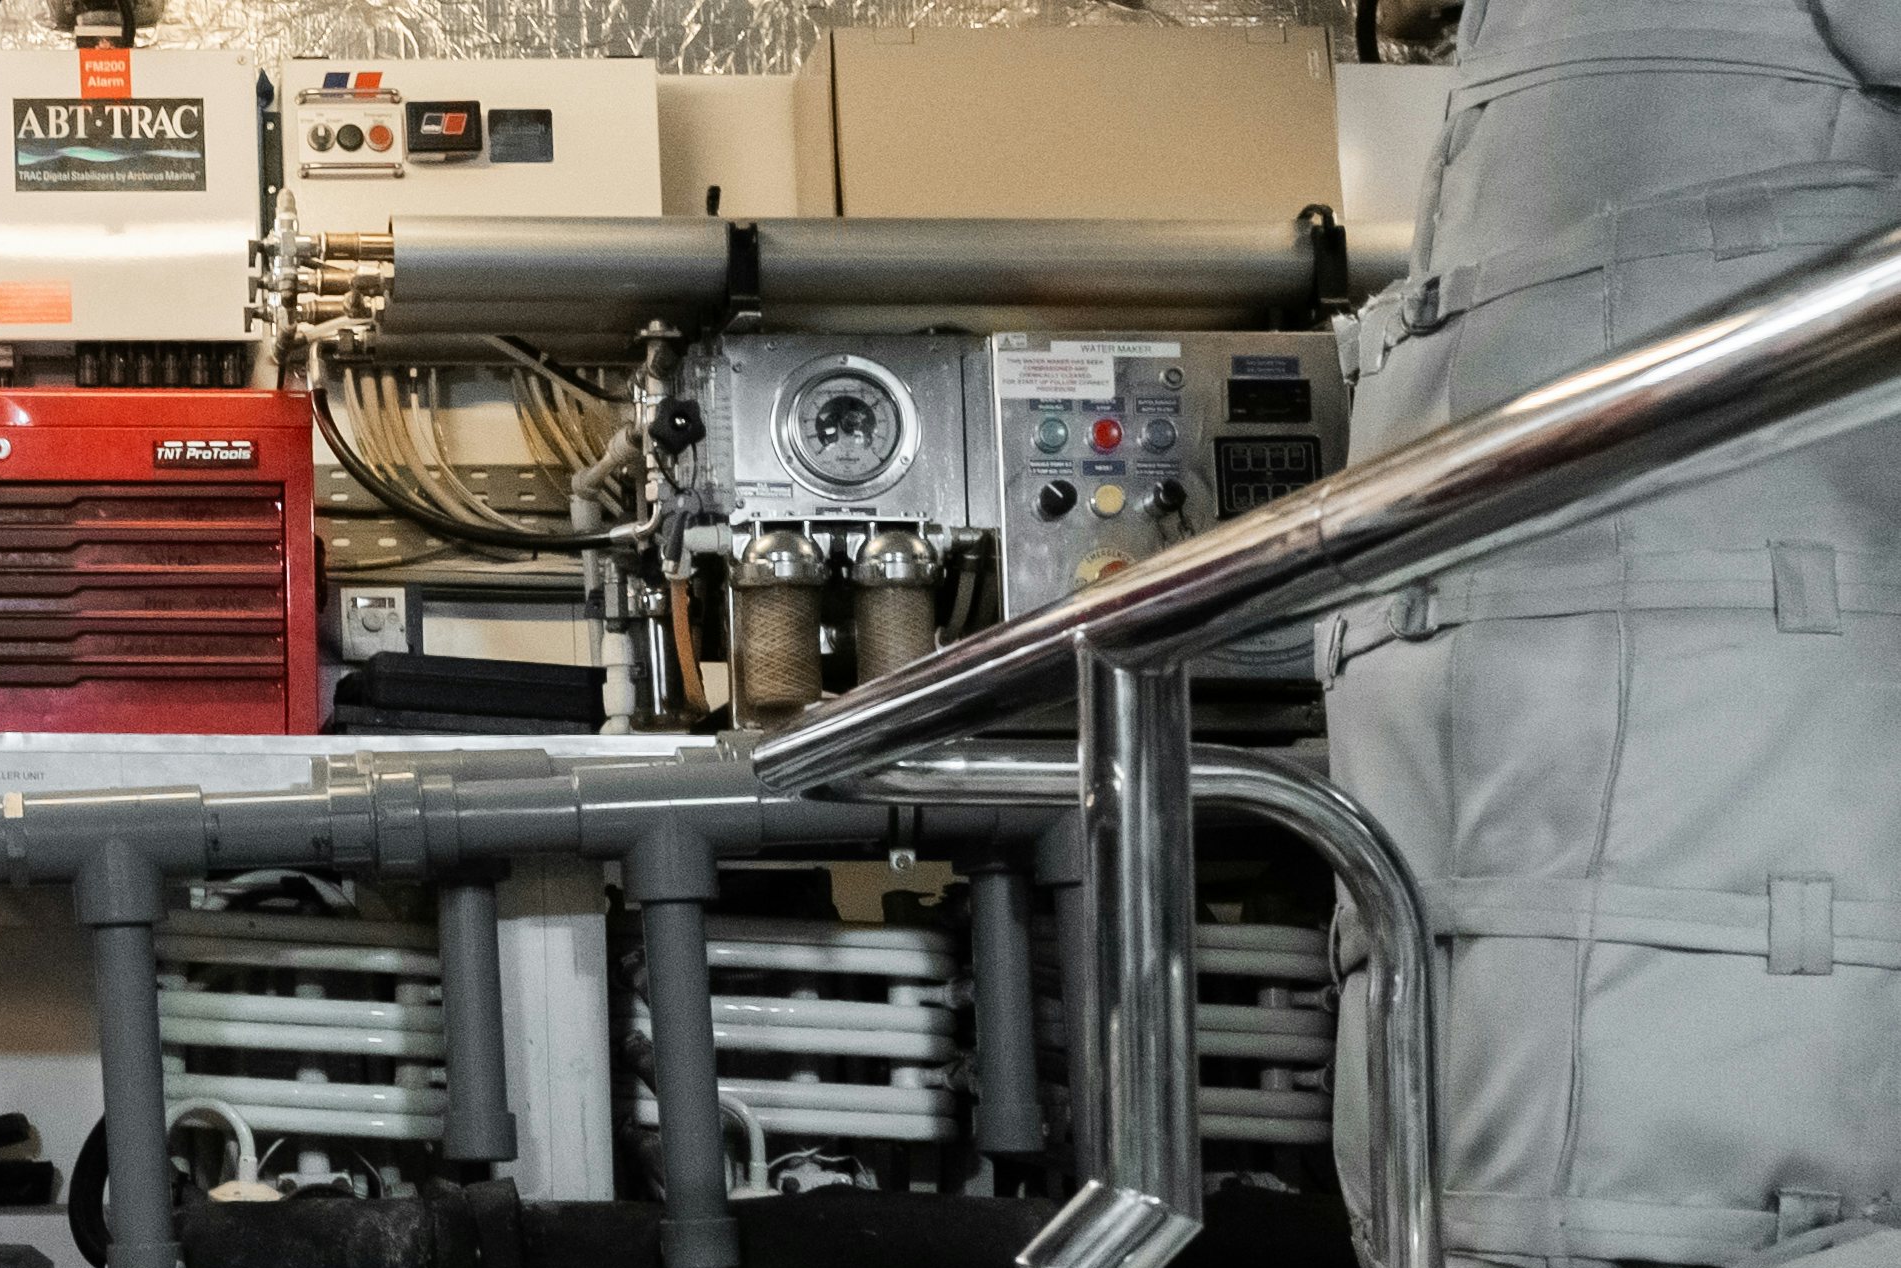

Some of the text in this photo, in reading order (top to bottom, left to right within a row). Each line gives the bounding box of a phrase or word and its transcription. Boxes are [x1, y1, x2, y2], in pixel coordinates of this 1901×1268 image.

[84, 60, 126, 73] FM200
[87, 76, 125, 88] Alarm
[18, 171, 42, 181] TRAC
[43, 171, 71, 182] Digital
[71, 171, 115, 182] Stabilizers
[115, 171, 127, 183] by
[1080, 343, 1152, 353] WATER MAKER
[156, 447, 252, 460] TNT ProTools
[22, 770, 45, 780] UNIT
